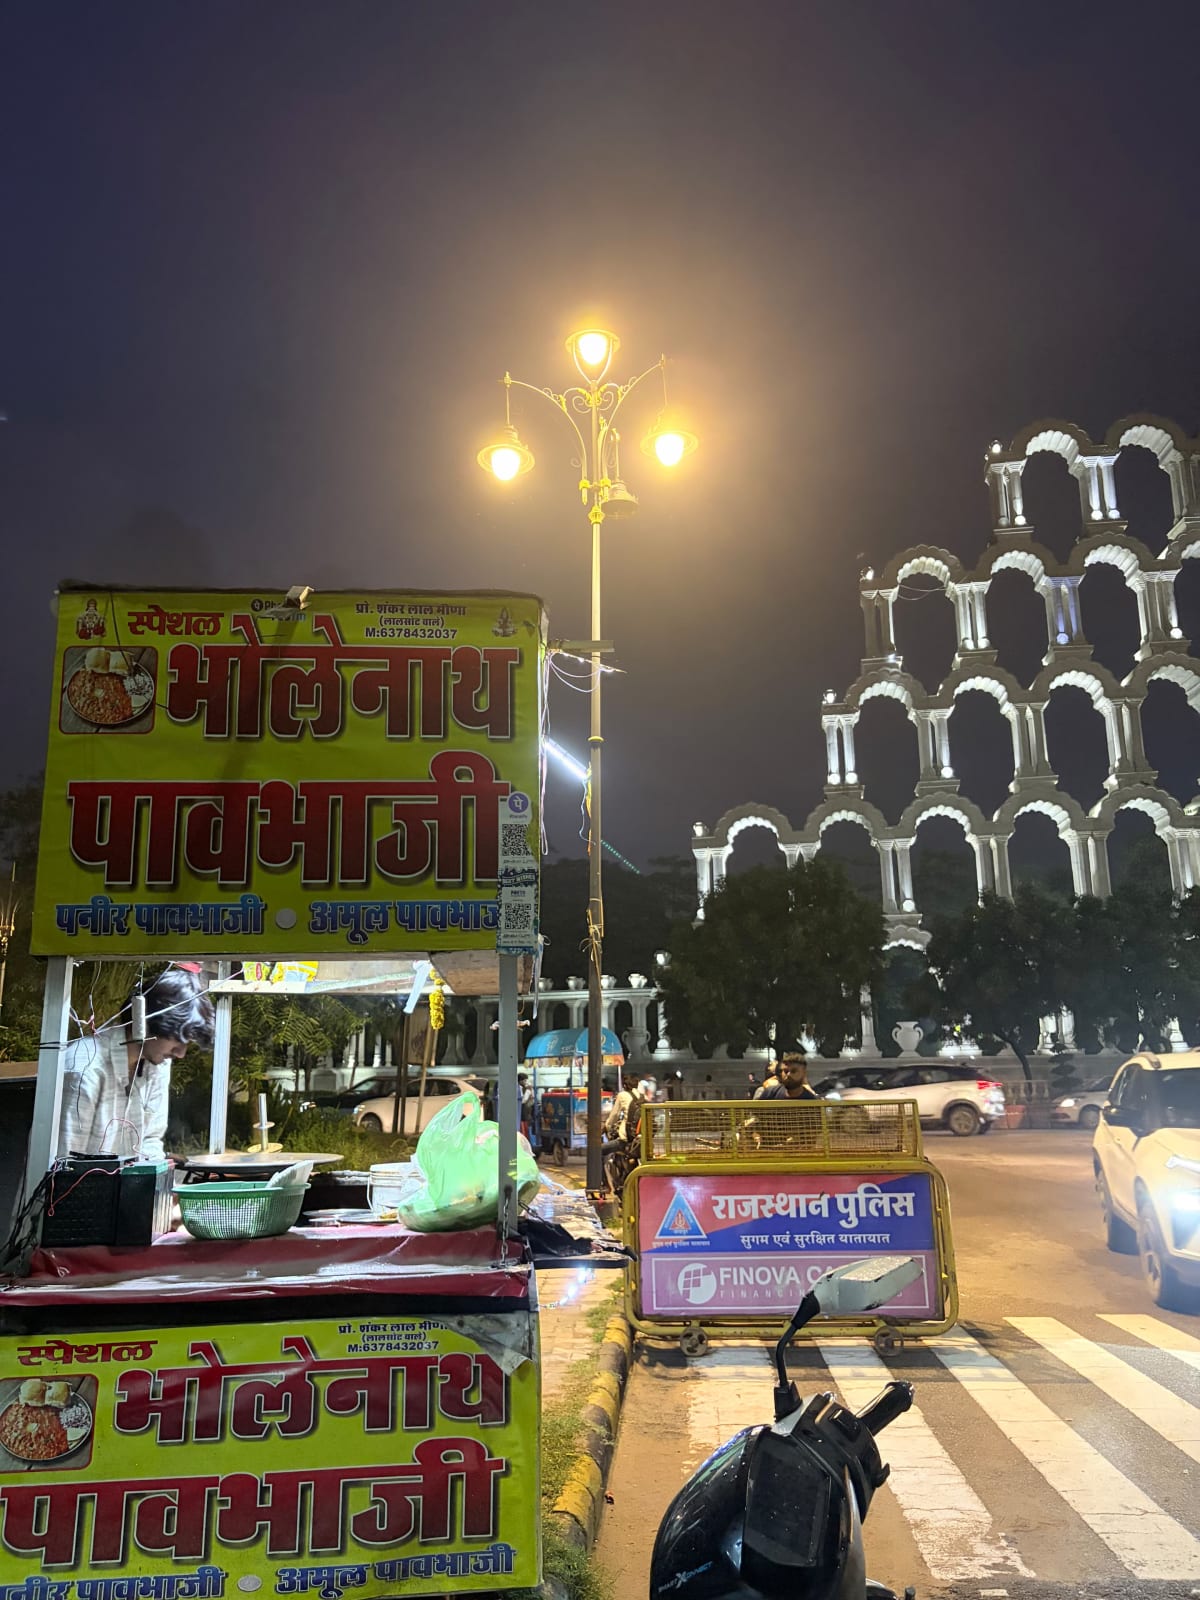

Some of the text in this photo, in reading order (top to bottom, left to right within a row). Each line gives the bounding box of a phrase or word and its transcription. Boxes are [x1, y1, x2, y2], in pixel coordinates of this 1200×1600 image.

[126, 604, 225, 637] स्पेशल
[408, 604, 434, 615] लाल
[365, 627, 458, 639] M:6378432037
[166, 612, 521, 740] भोलेनाथ
[67, 750, 512, 885] पावभाजी
[56, 893, 266, 934] पनीर पावभाजी
[310, 900, 498, 944] अमूल पावभाज
[711, 1182, 915, 1229] राजस्थान पुलिस
[740, 1230, 890, 1249] सुगम एवं सुरक्षित यातायात
[719, 1266, 800, 1286] FINOVA
[390, 1322, 416, 1332] लाल
[16, 1339, 158, 1367] स्पेशल
[347, 1341, 439, 1353] M:6378432037
[114, 1335, 508, 1444] भोलेनाथ
[0, 1437, 505, 1569] पावभाजी
[76, 1565, 227, 1600] पावभाजी
[275, 1544, 516, 1600] अमूल पावभाजी
